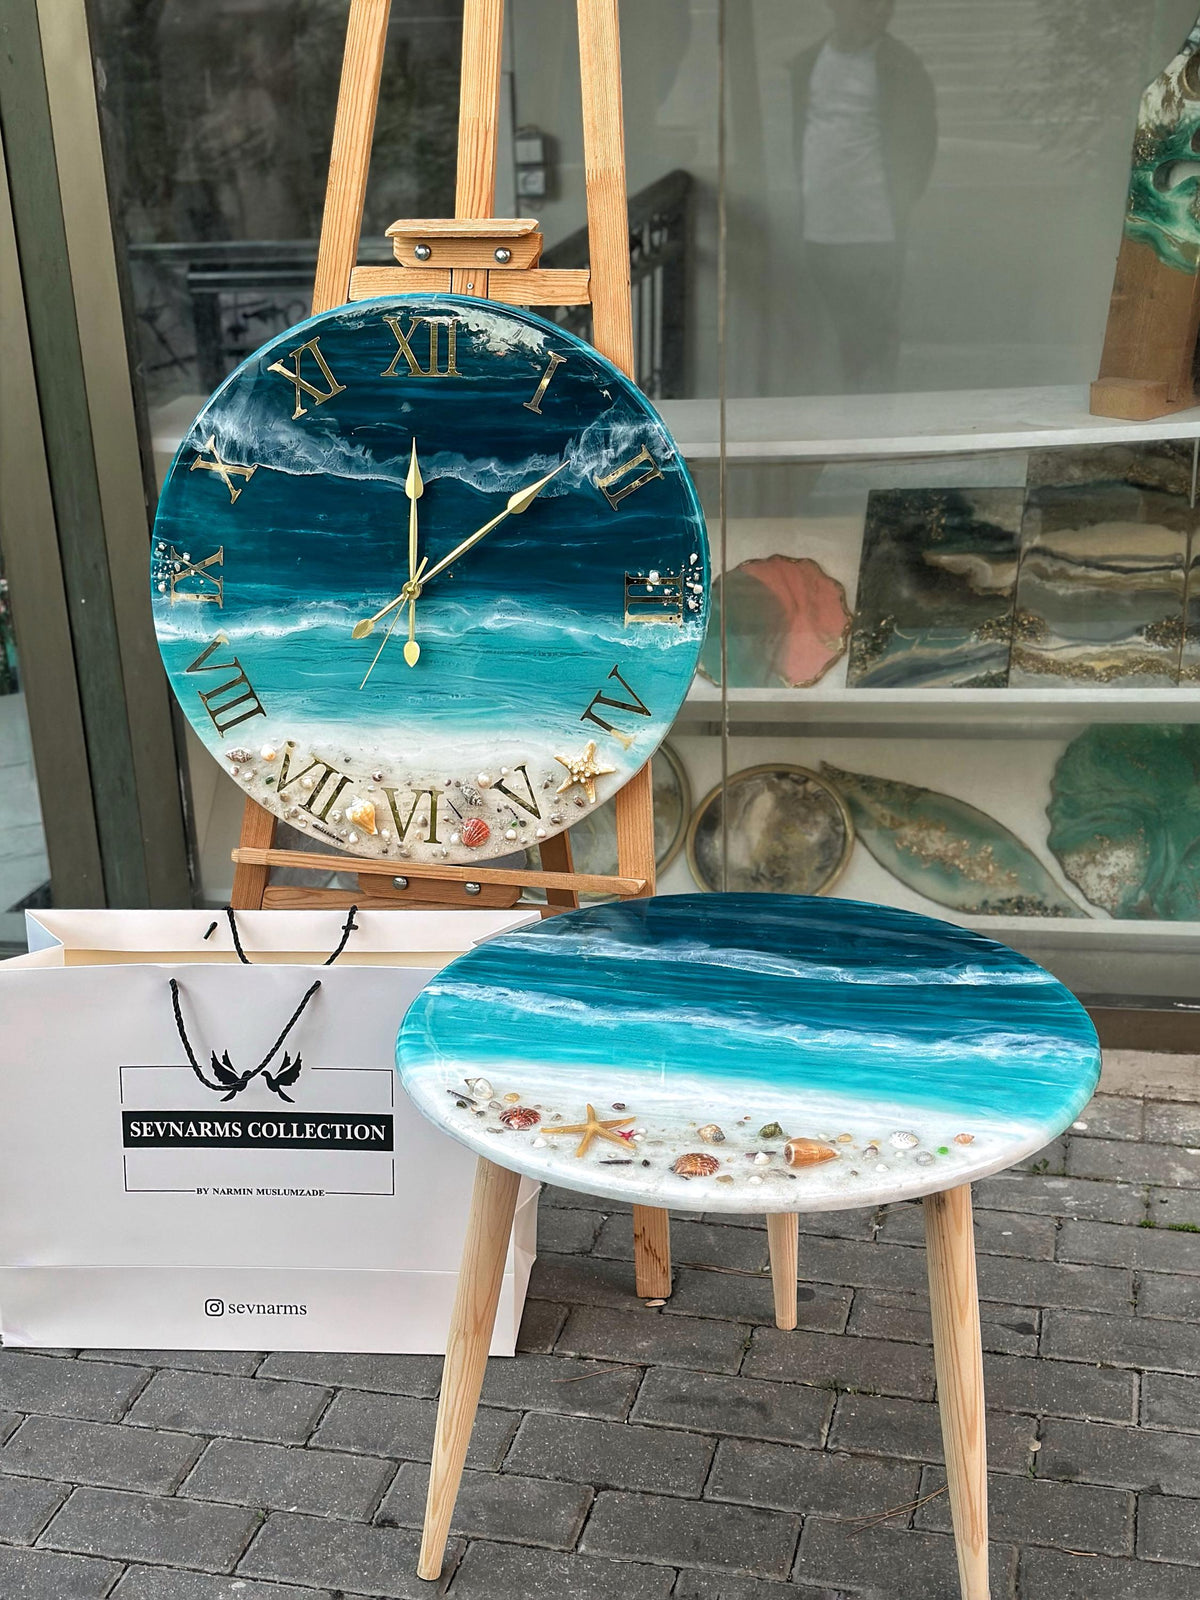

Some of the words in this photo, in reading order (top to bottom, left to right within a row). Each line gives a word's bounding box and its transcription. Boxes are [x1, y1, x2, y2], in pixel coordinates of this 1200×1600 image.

[380, 316, 462, 378] XII
[267, 336, 347, 420] XI
[190, 434, 258, 504] X
[129, 1121, 242, 1138] SEVNARMS
[247, 1123, 386, 1141] COLLECTION
[196, 1187, 209, 1195] BY
[212, 1187, 253, 1196] NARMIN
[256, 1188, 325, 1197] MUSLUMZADE
[228, 1303, 307, 1316] sevnarms
